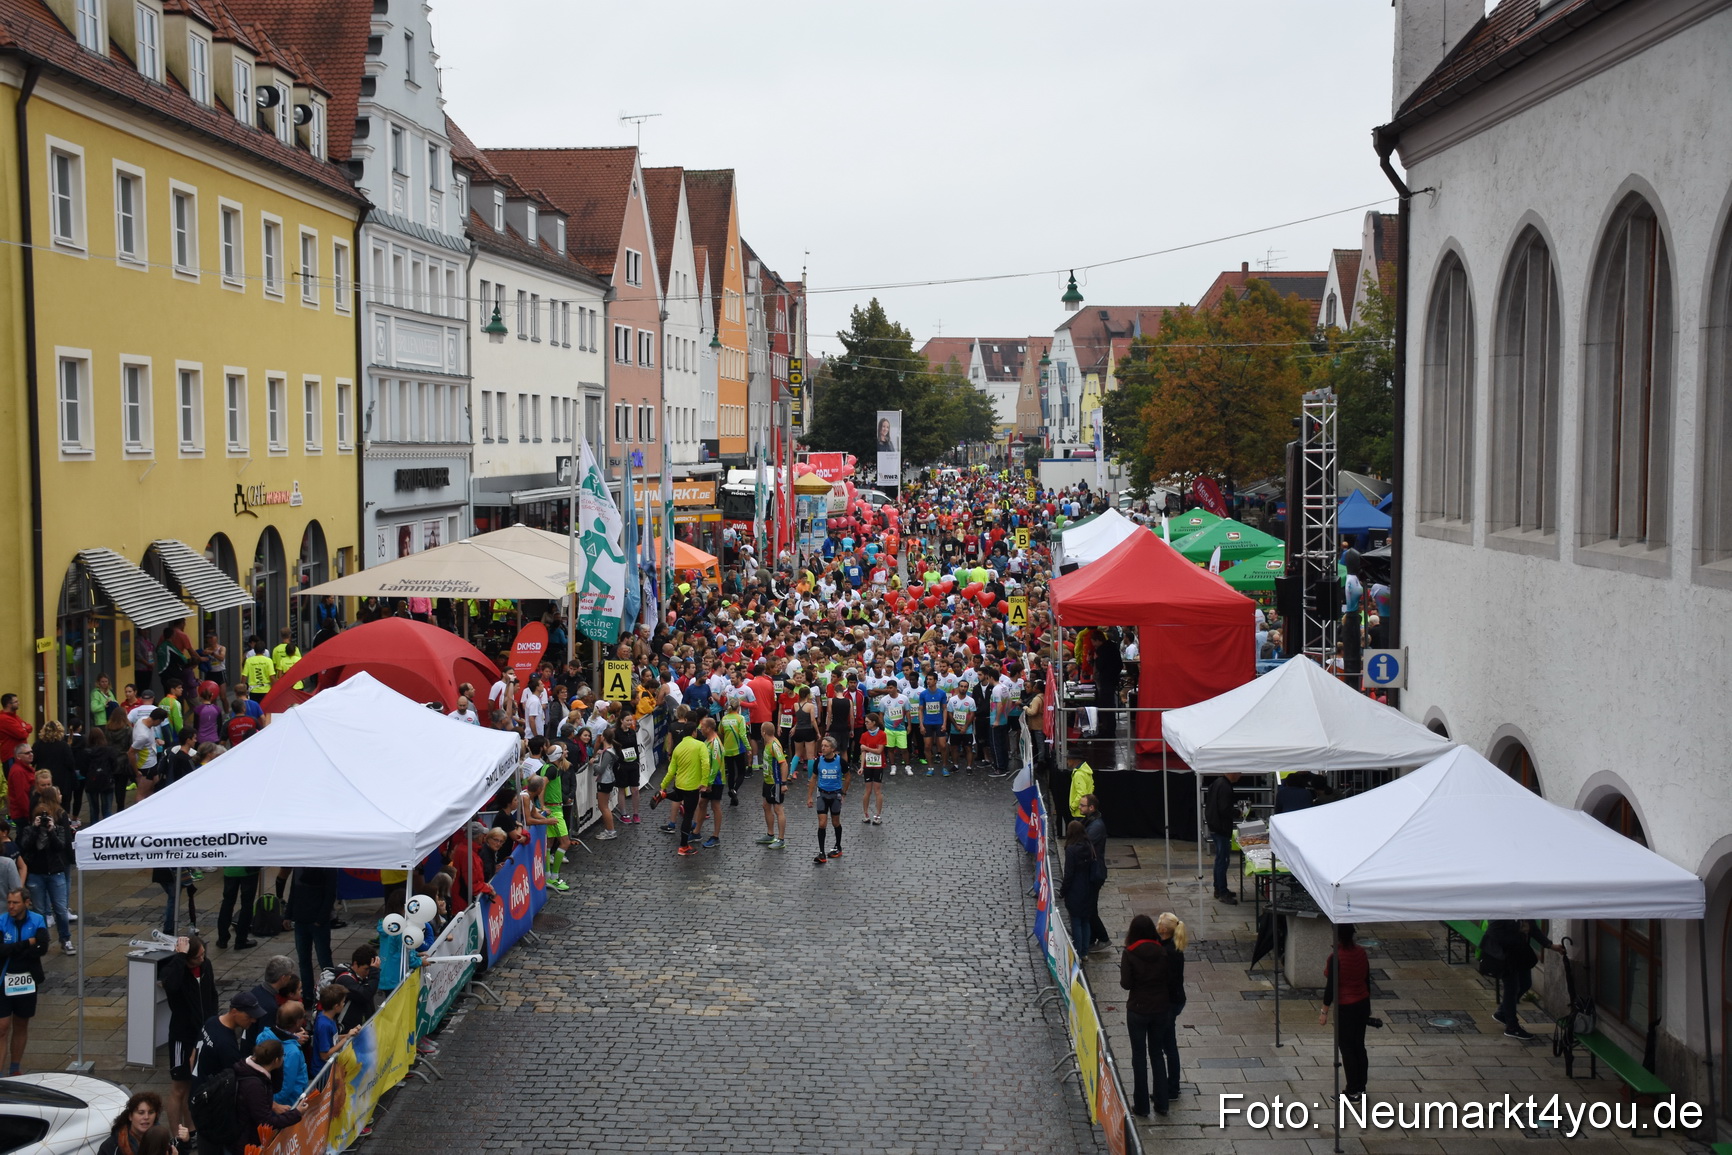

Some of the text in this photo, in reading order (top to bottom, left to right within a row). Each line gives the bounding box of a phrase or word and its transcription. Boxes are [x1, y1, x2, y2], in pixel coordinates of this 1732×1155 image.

[789, 360, 802, 425] HOTEL
[1028, 491, 1034, 499] C
[732, 522, 747, 530] AVIA
[1019, 535, 1027, 545] B
[379, 584, 480, 593] Lammsbräu
[1012, 605, 1024, 619] A
[607, 662, 629, 670] Block
[610, 673, 625, 692] A
[92, 833, 268, 848] BMW ConnectedDrive
[93, 851, 143, 861] Vernetzt,
[165, 850, 184, 859] frei
[201, 849, 227, 858] sein.
[8, 975, 32, 986] 2206
